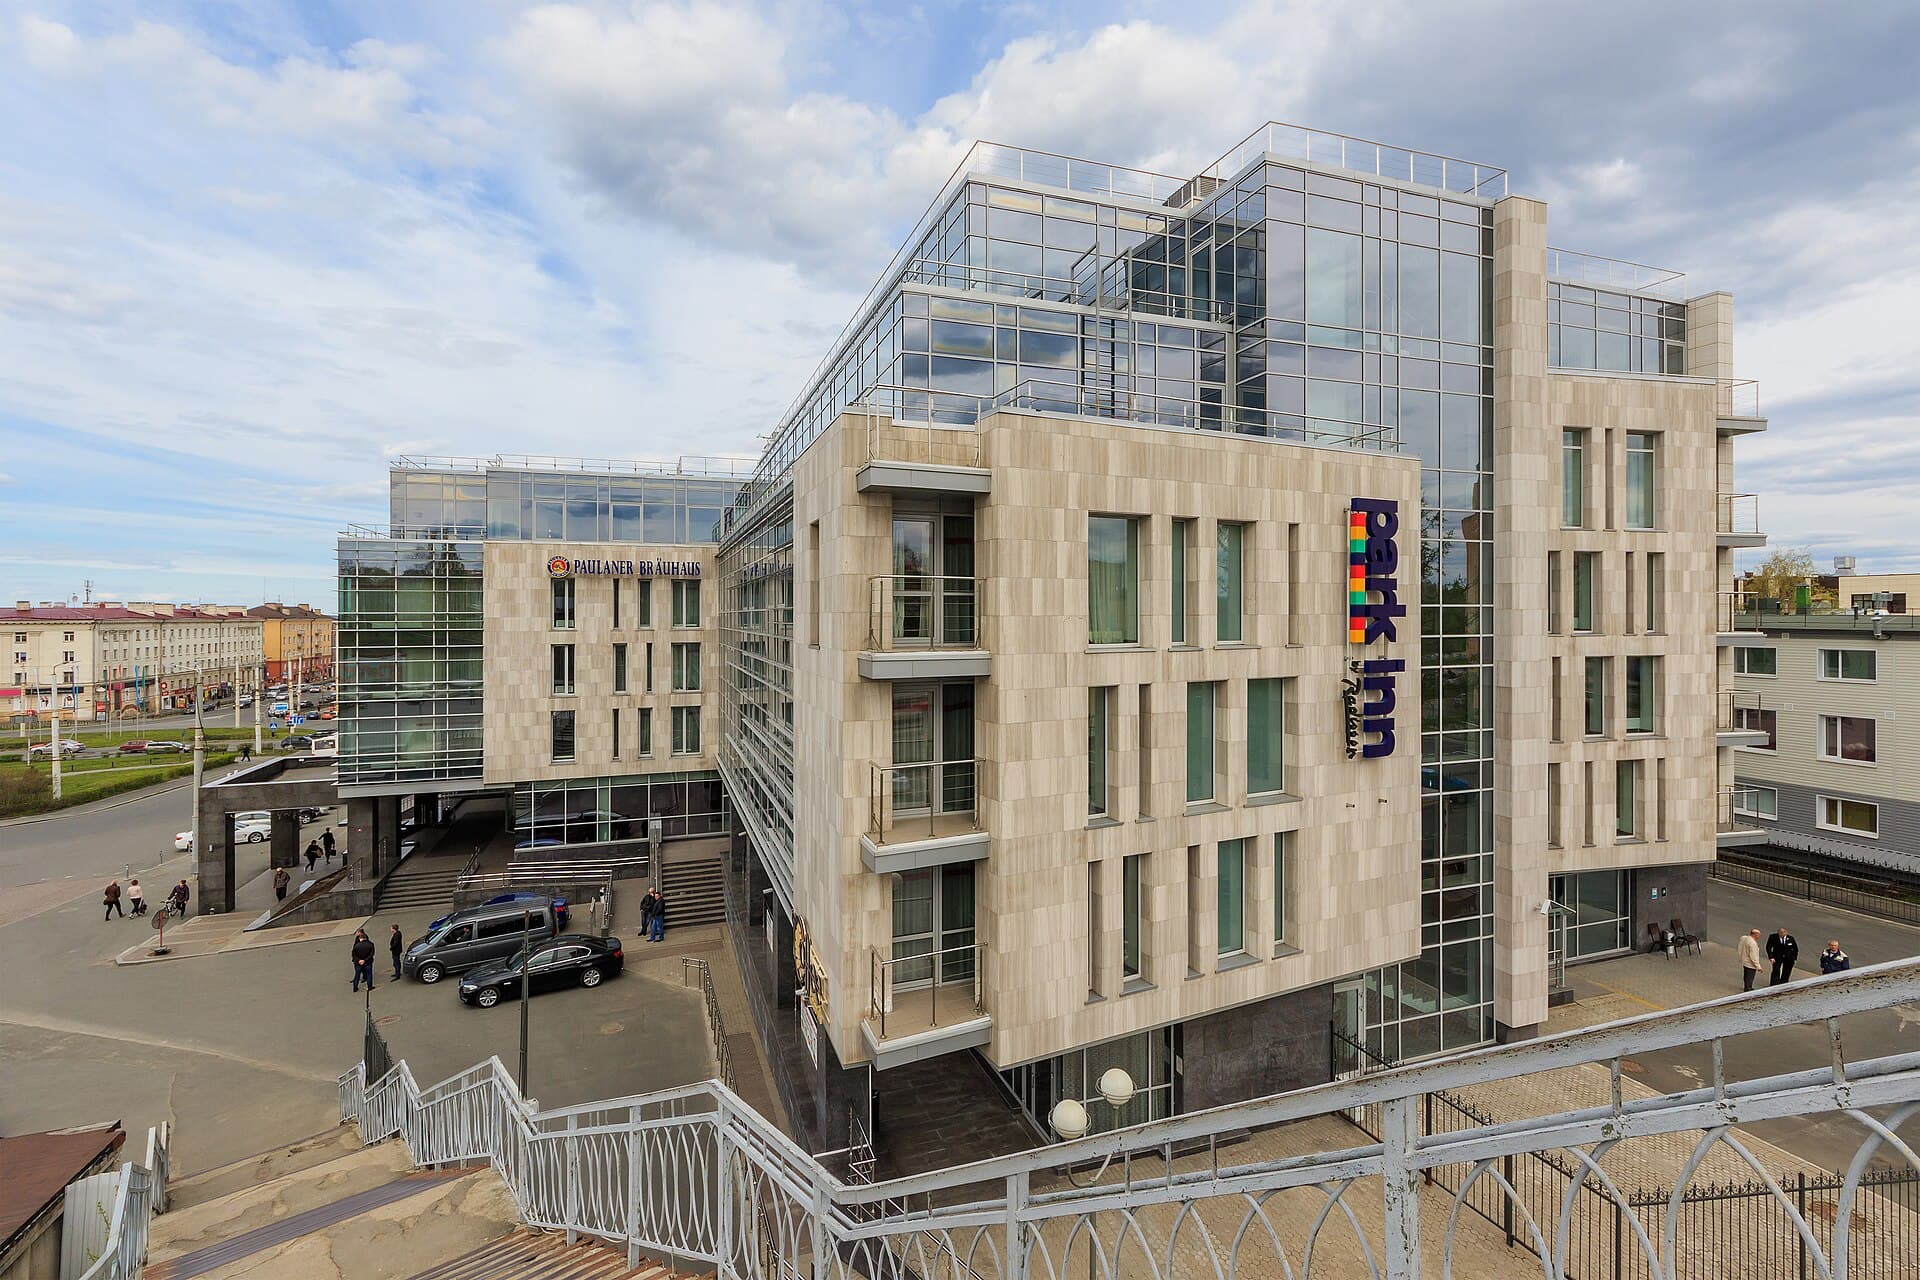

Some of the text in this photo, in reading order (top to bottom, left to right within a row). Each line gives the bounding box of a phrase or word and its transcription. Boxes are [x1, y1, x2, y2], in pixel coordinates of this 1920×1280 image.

[574, 559, 633, 575] PAULANER
[640, 558, 700, 575] BRÄUHAUS
[1350, 497, 1406, 758] park Inn
[1341, 677, 1364, 760] Radisson
